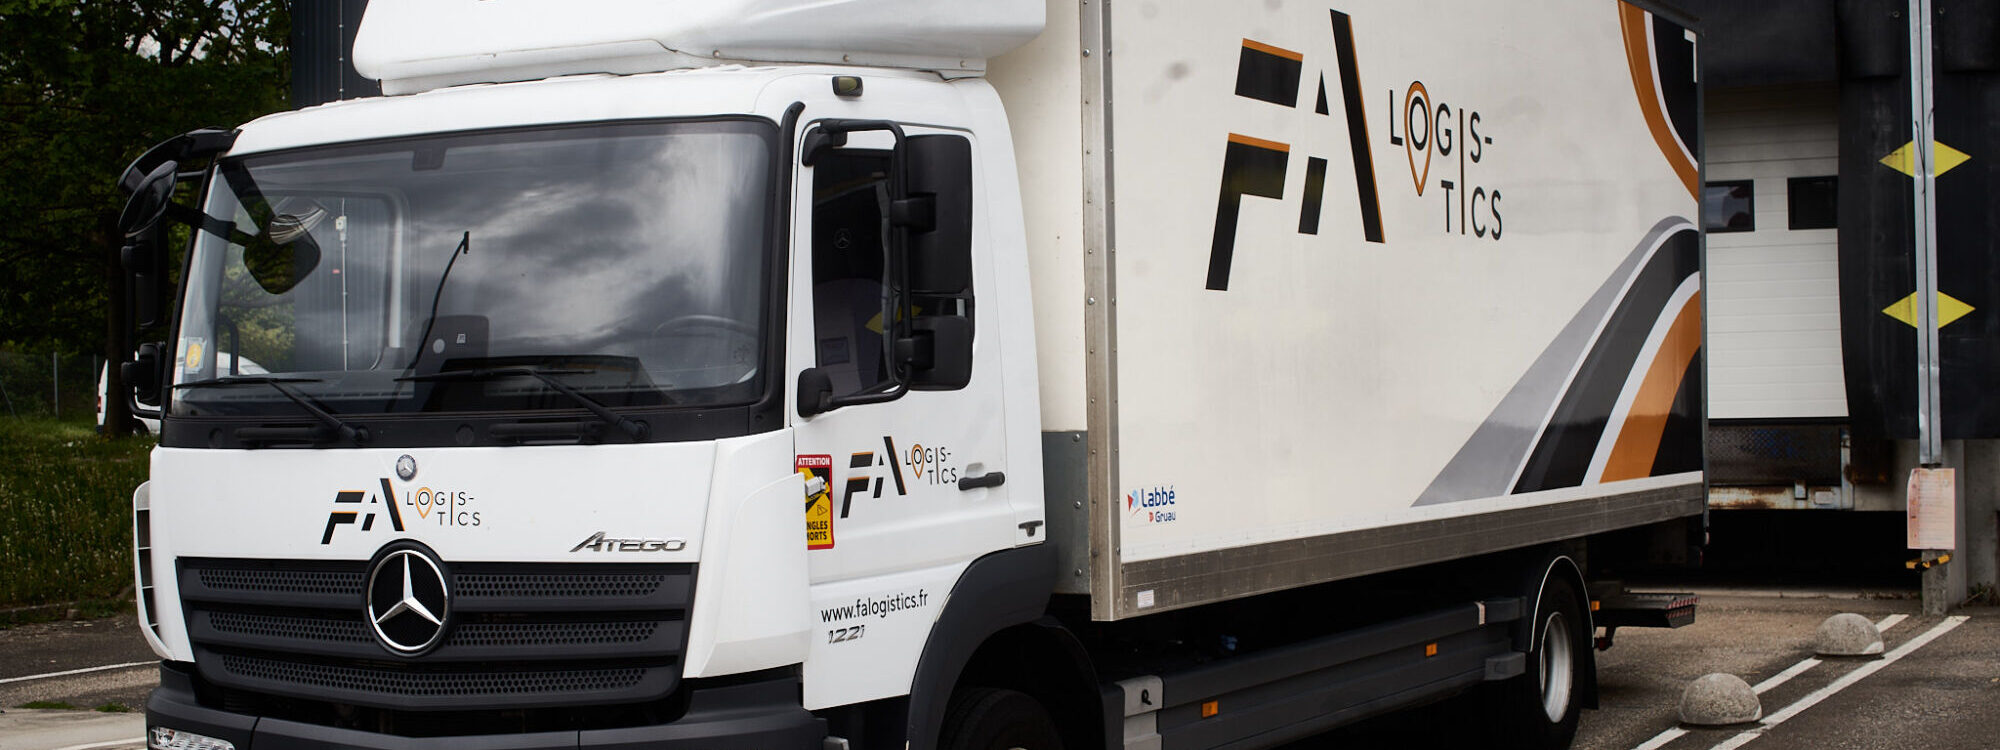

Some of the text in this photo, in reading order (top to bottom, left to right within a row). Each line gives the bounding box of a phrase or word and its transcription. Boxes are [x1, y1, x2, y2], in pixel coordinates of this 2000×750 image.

[1205, 8, 1386, 292] FA
[1440, 178, 1503, 241] TICS
[797, 457, 831, 466] ATTENTION
[840, 435, 907, 519] FA
[927, 467, 957, 486] TICS
[1141, 485, 1176, 508] Labbé
[321, 477, 405, 545] FA
[437, 512, 481, 526] TICS
[1155, 510, 1176, 523] Gruau
[806, 520, 829, 530] NGLES
[820, 588, 929, 623] www.falogistics.fr
